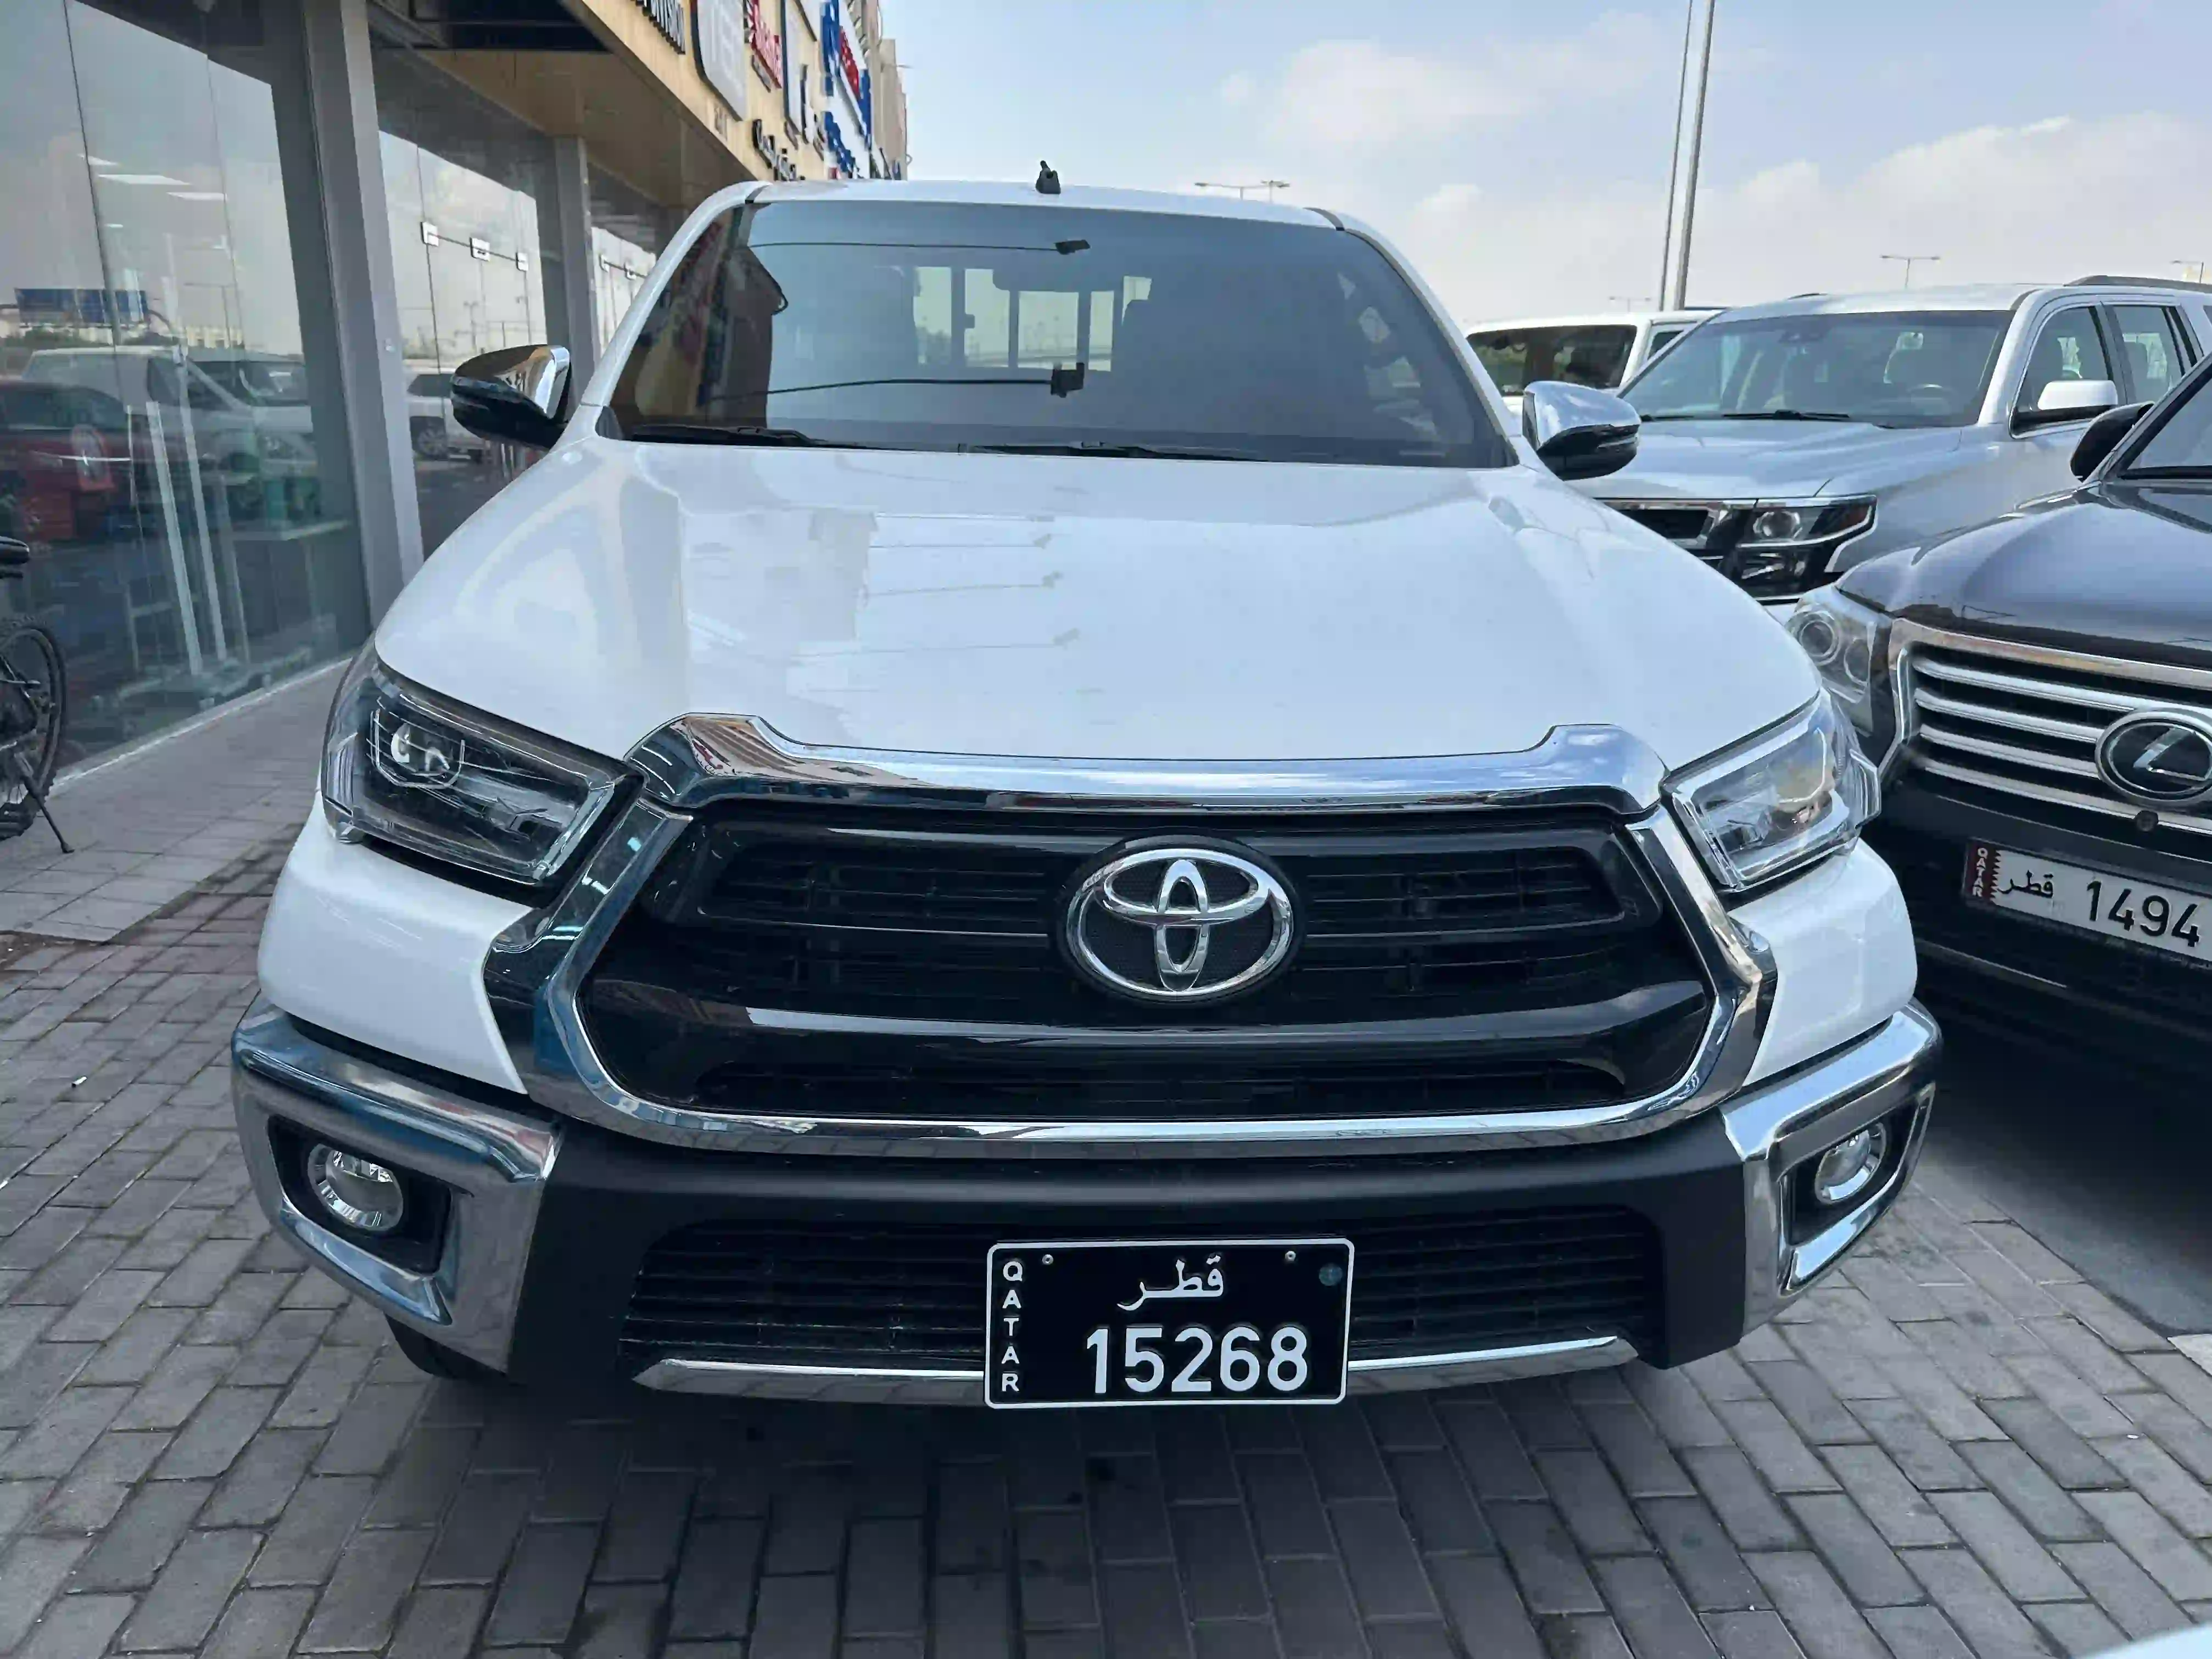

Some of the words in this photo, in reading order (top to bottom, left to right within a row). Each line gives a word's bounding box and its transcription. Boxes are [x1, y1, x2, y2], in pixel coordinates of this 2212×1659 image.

[1972, 847, 1988, 897] QATAR
[1997, 870, 2054, 898] قطر
[2087, 880, 2200, 948] 1494
[1116, 1254, 1224, 1311] قطر
[1001, 1261, 1023, 1392] QATAR
[1086, 1326, 1308, 1394] 15268
